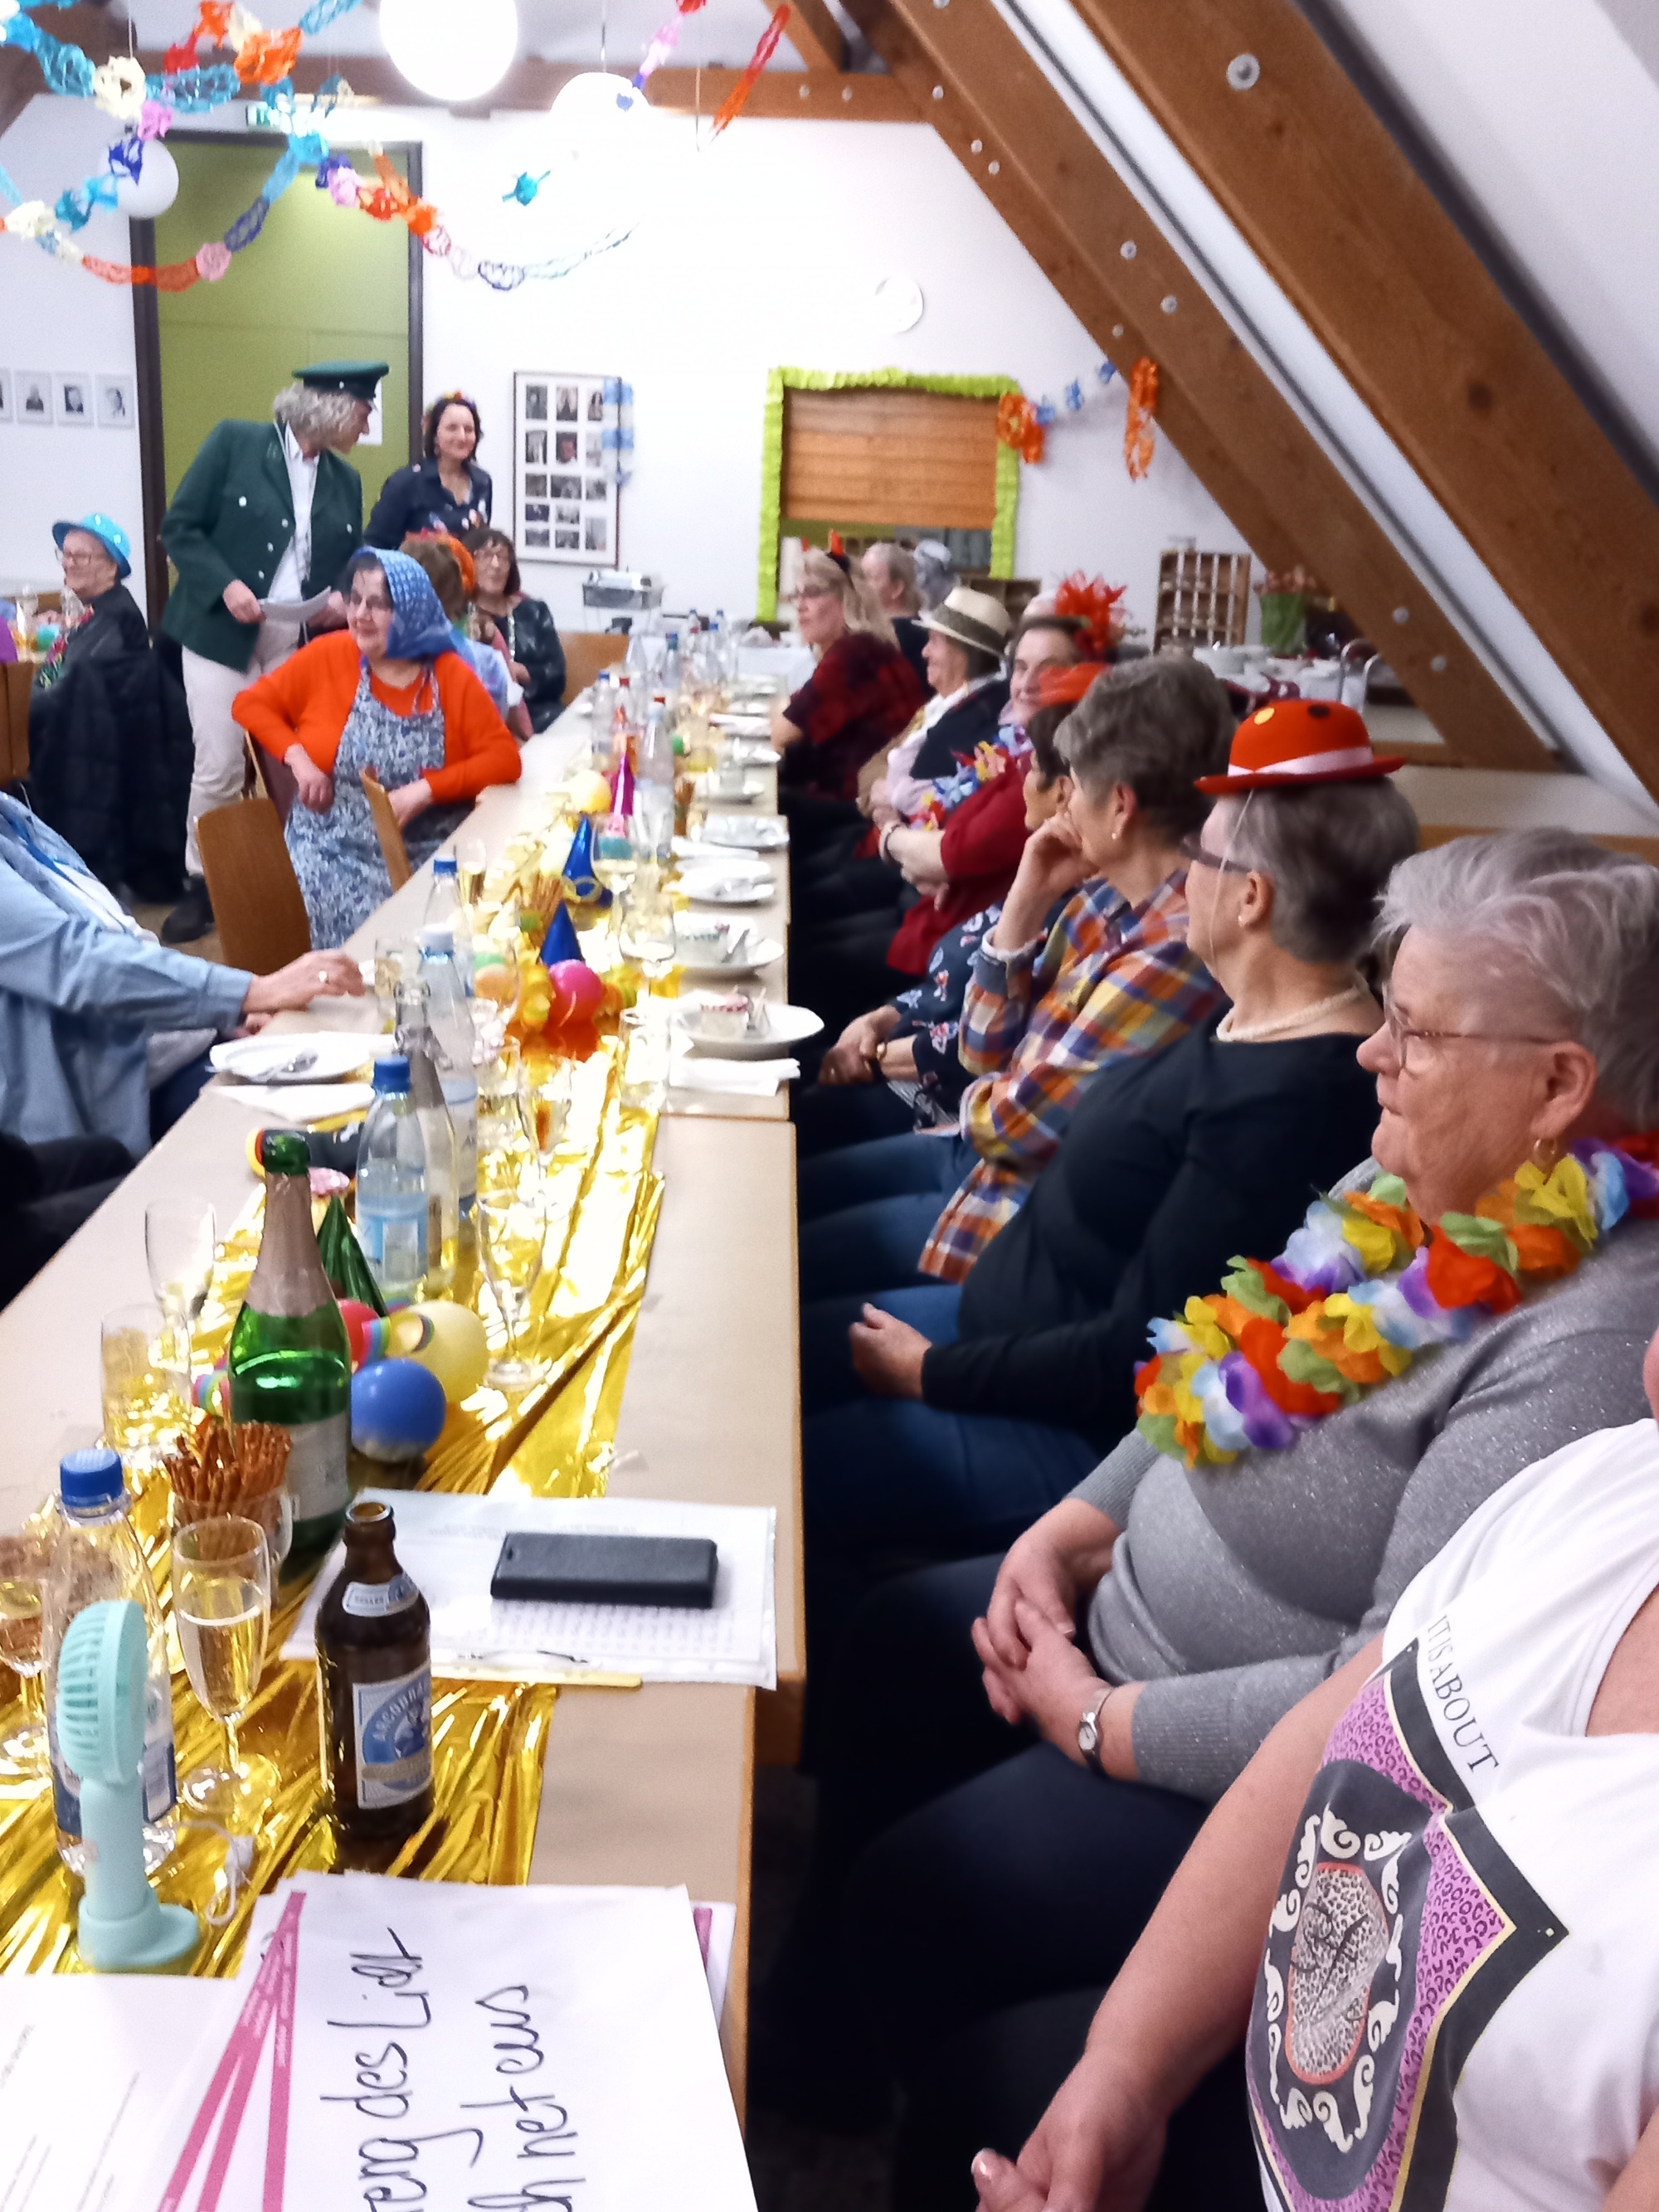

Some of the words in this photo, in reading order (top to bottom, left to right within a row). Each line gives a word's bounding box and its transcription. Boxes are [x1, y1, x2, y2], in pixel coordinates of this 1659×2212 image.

[1428, 1614, 1451, 1643] IT
[1428, 1637, 1453, 1662] IS
[1429, 1661, 1500, 1773] ABOUT
[319, 2041, 413, 2119] des
[460, 2084, 579, 2159] net
